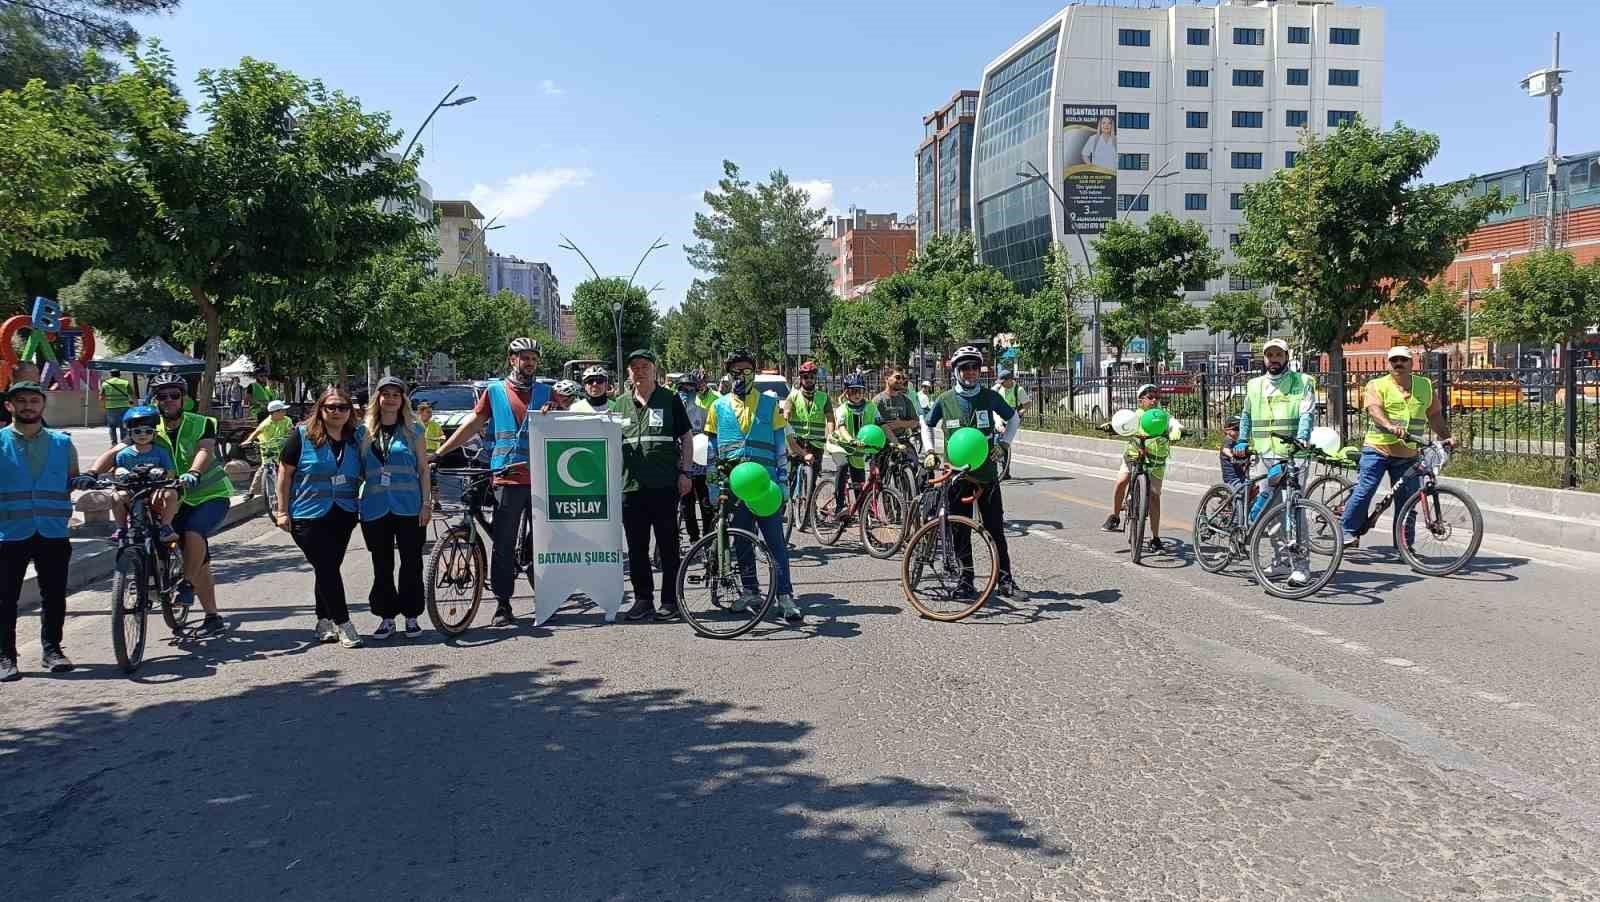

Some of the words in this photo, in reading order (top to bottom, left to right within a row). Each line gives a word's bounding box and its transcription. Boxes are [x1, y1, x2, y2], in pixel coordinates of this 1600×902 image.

[555, 499, 602, 517] YEŞİLAY
[538, 551, 582, 565] BATMAN
[584, 549, 620, 566] ŞUBESİ
